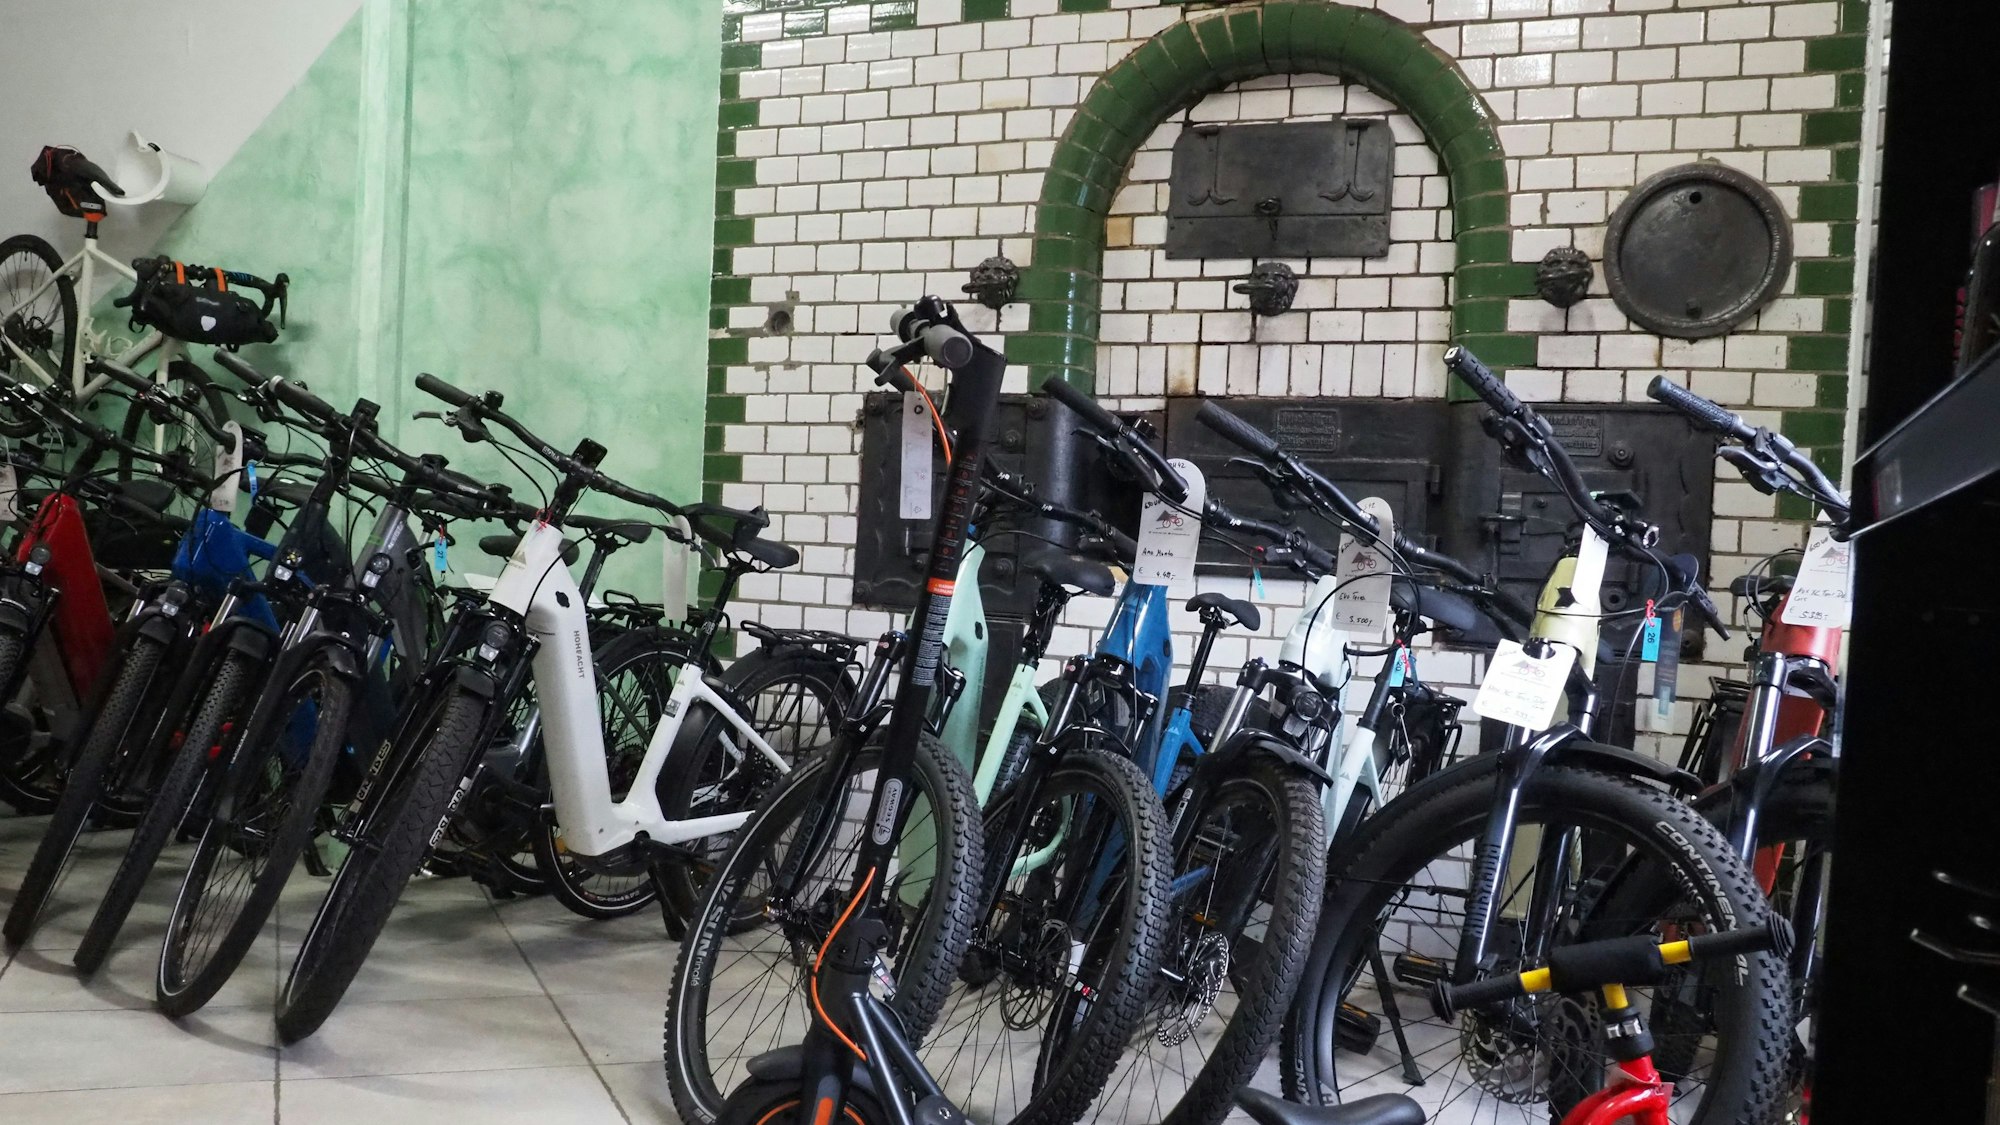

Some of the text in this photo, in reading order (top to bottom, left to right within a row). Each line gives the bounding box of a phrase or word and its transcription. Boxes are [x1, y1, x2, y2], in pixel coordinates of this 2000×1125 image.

[1647, 632, 1656, 644] 26
[1395, 660, 1403, 672] 20
[885, 787, 898, 823] SEGWAY
[1463, 842, 1500, 939] ROCKSHOX
[1656, 820, 1749, 987] CONTINENAL
[697, 905, 725, 959] SUN
